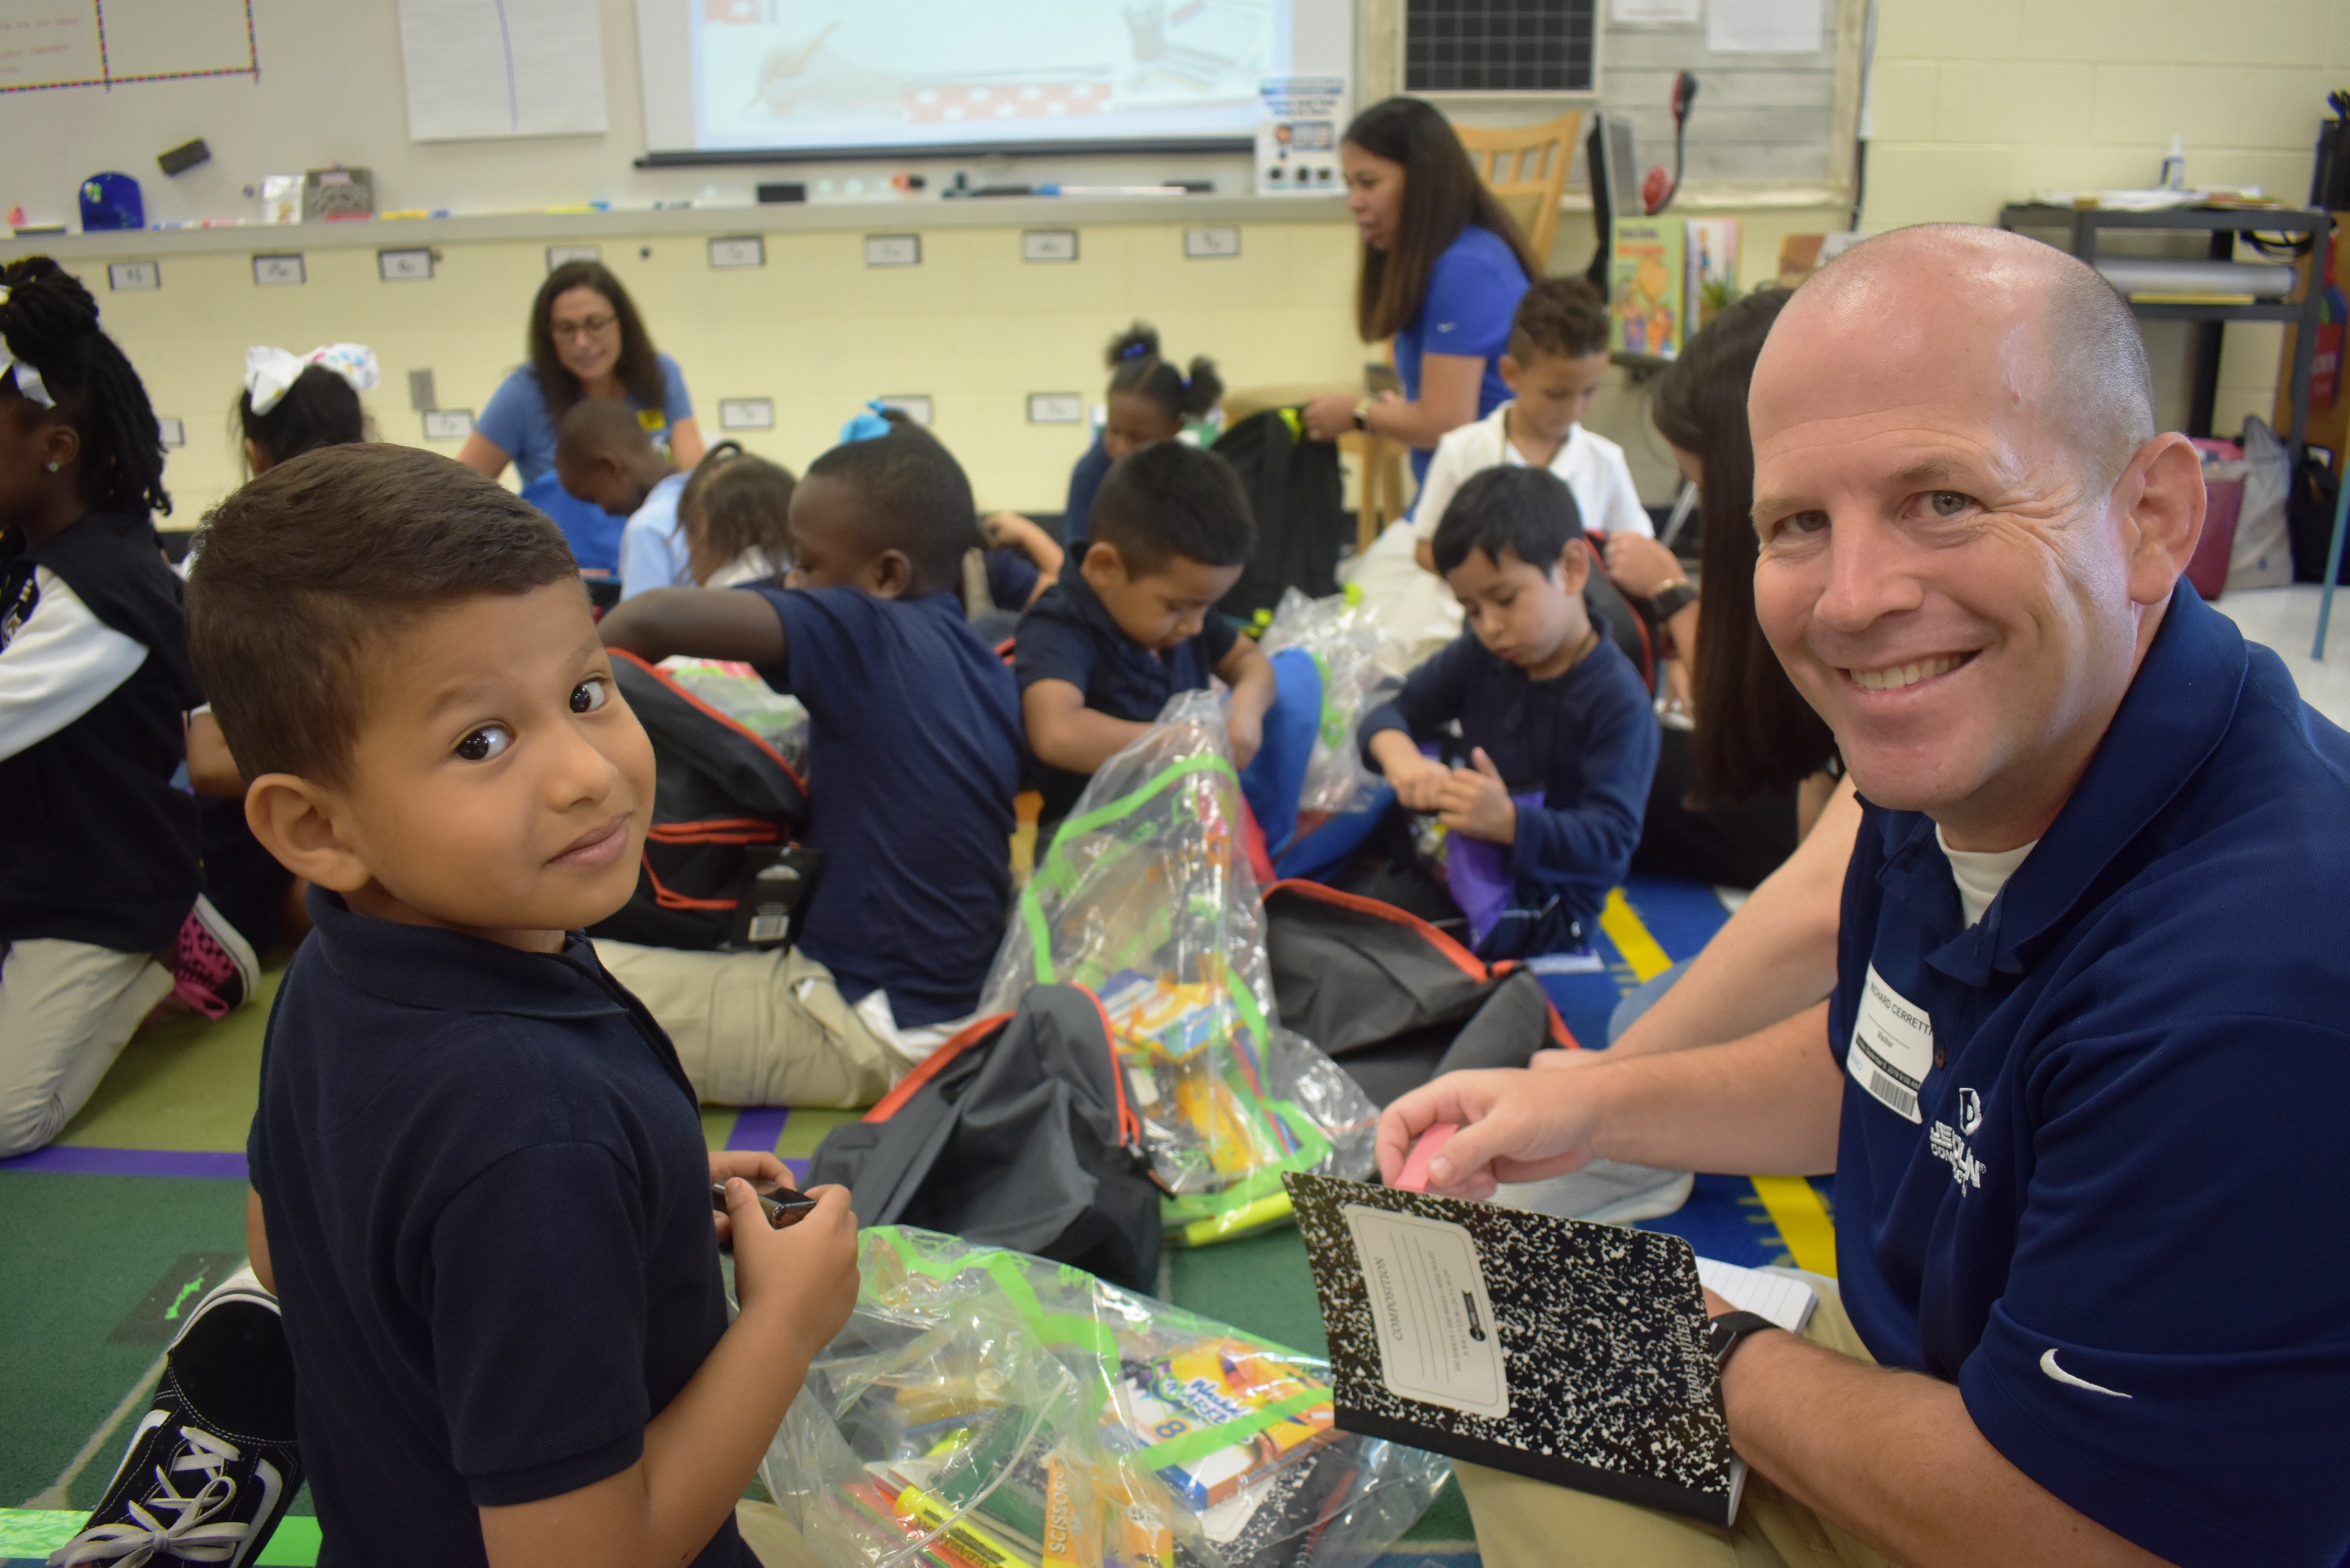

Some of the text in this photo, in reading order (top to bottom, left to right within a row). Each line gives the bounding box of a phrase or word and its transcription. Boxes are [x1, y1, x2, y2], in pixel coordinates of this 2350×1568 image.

[1871, 982, 1891, 1011] RICHARD
[1878, 1031, 1894, 1047] Visitor
[1374, 1256, 1403, 1341] COMPOSITION
[1674, 1313, 1703, 1403] WIDE RULED
[1155, 1421, 1186, 1438] 8
[1049, 1471, 1068, 1554] SCISSORS
